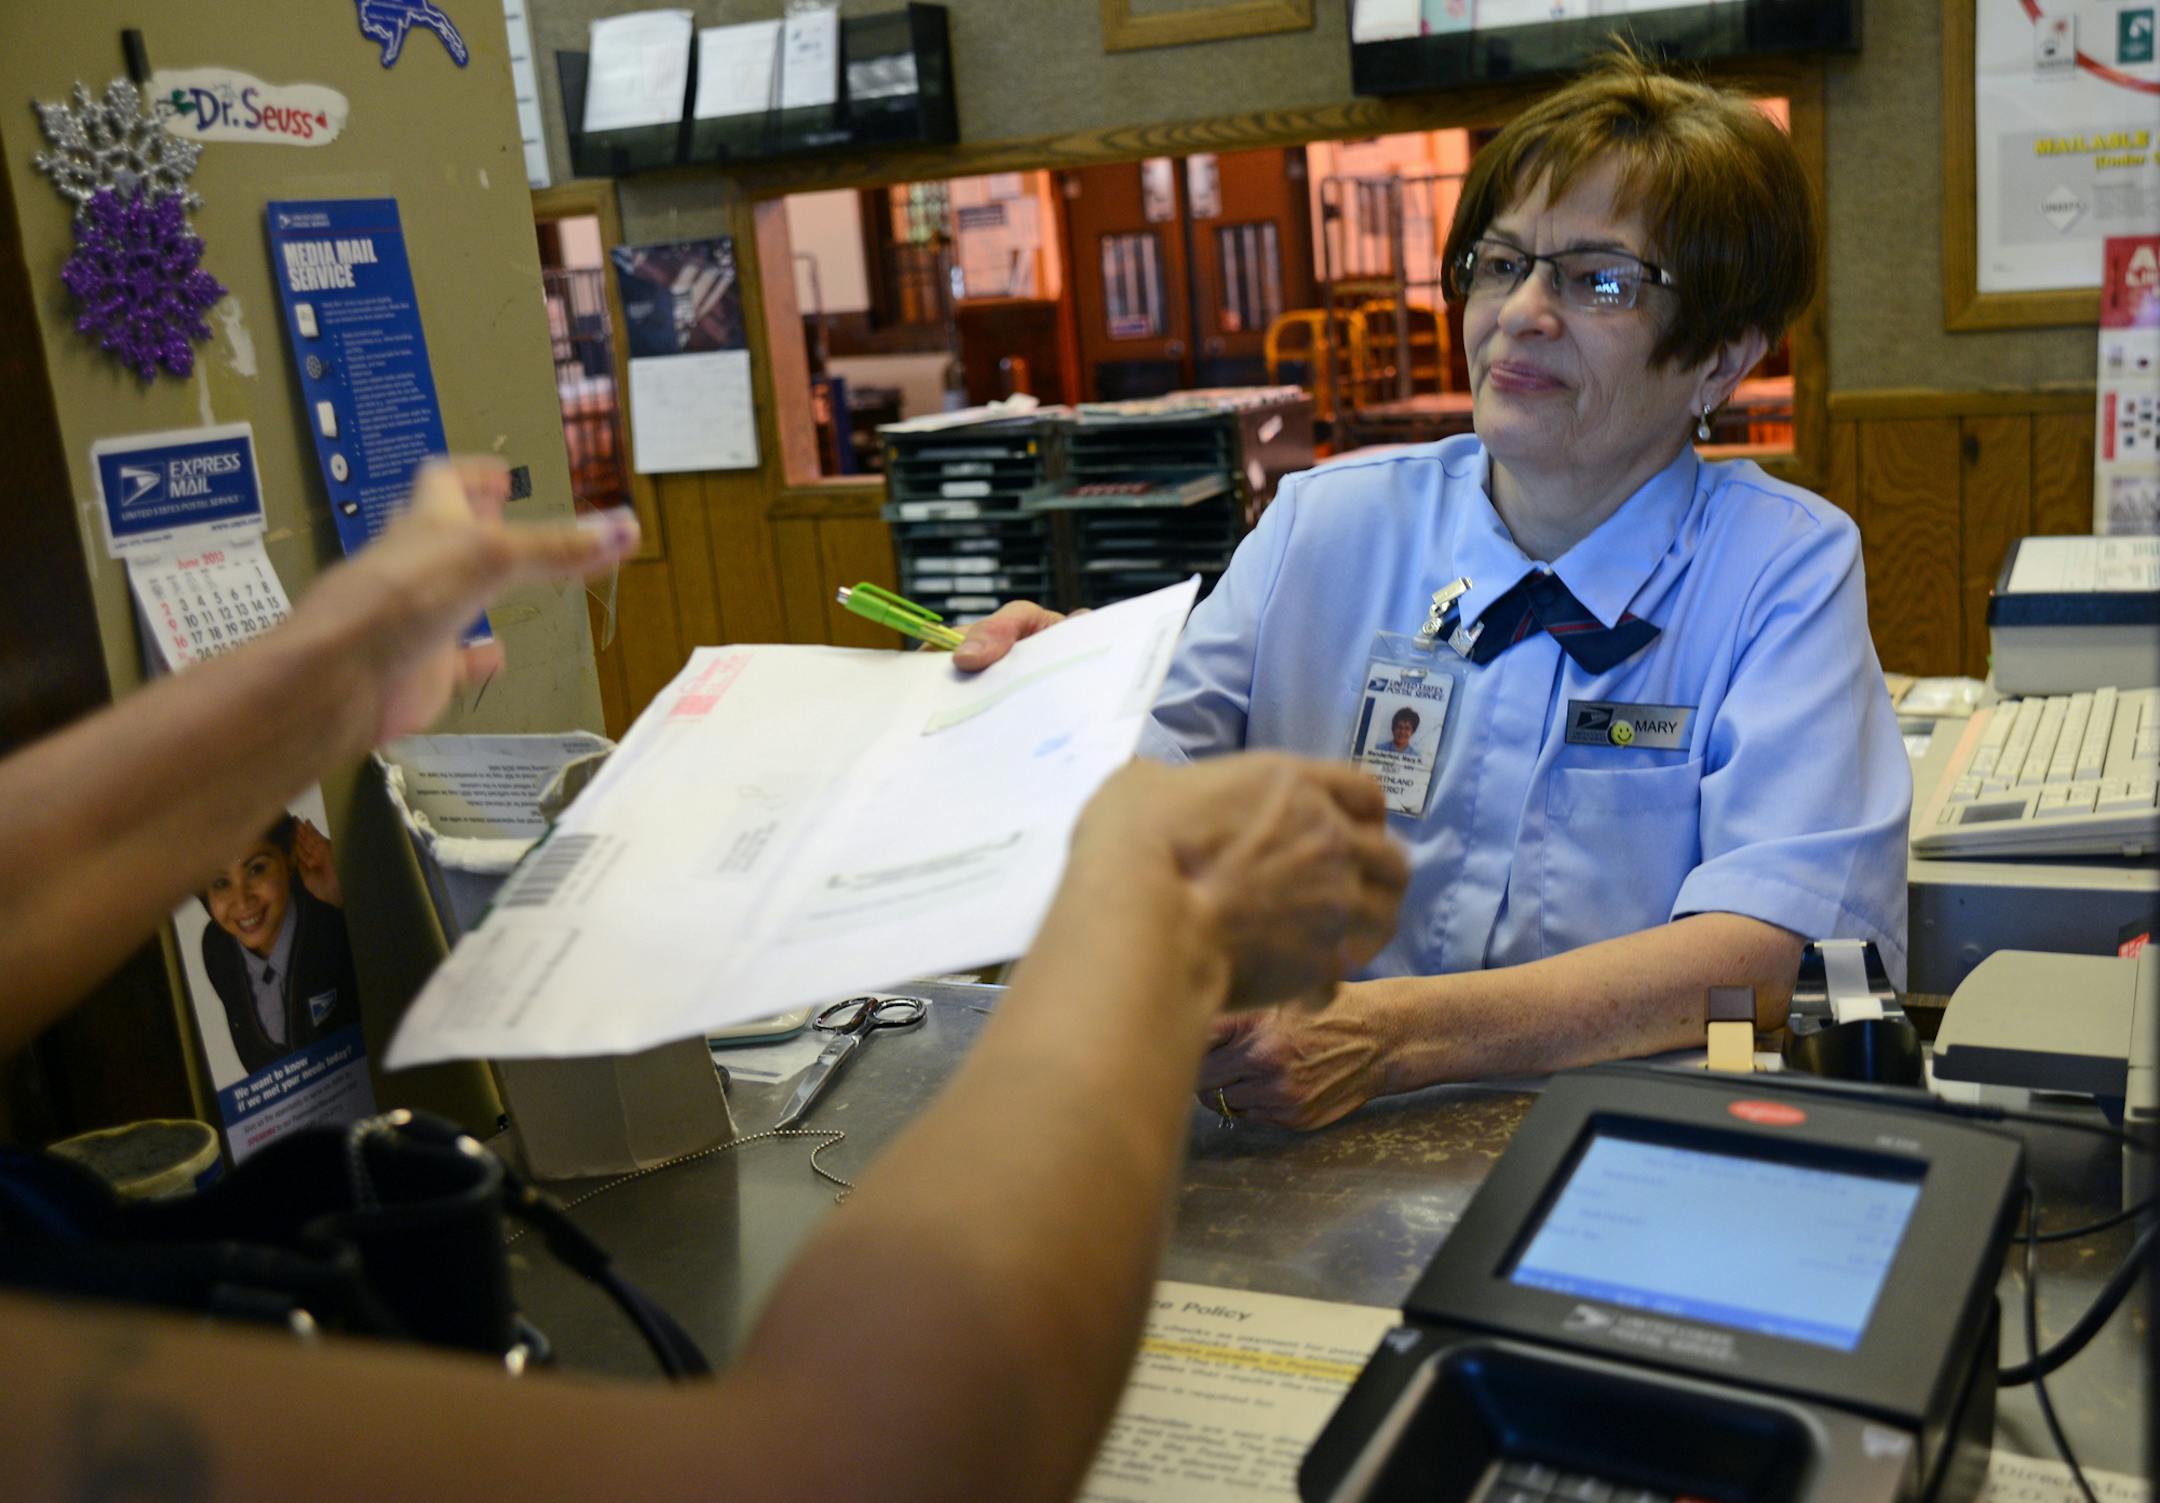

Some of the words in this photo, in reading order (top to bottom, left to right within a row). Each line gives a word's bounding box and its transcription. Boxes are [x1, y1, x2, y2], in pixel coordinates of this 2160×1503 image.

[189, 87, 239, 131] Dr.
[241, 87, 313, 139] Seuss
[2034, 129, 2150, 156] MAILABLE
[283, 241, 338, 268] MEDIA
[335, 238, 378, 264] MAIL
[288, 263, 356, 292] SERVICE
[169, 453, 241, 478] EXPRESS
[169, 478, 212, 499] MAIL
[209, 494, 240, 506] SERVICE
[178, 598, 189, 612] 3
[213, 591, 223, 604] 5
[230, 588, 239, 601] 6
[261, 581, 271, 594] 8
[167, 617, 178, 631] 9
[184, 615, 199, 629] 10
[202, 610, 215, 624] 11
[218, 606, 233, 620] 12
[235, 602, 249, 616] 13
[251, 599, 265, 613] 14
[266, 596, 281, 610] 15
[173, 635, 189, 649] 16
[190, 630, 203, 644] 17
[208, 626, 223, 641] 18
[225, 622, 239, 636] 19
[241, 618, 257, 632] 20
[257, 615, 271, 629] 21
[1635, 719, 1678, 734] MARY
[233, 1087, 250, 1100] We
[250, 1073, 273, 1092] want
[273, 1069, 284, 1081] to
[284, 1057, 309, 1075] know
[237, 1100, 246, 1113] if
[247, 1095, 261, 1109] we
[262, 1083, 281, 1101] met
[281, 1075, 300, 1094] your
[1182, 1301, 1253, 1322] Policy
